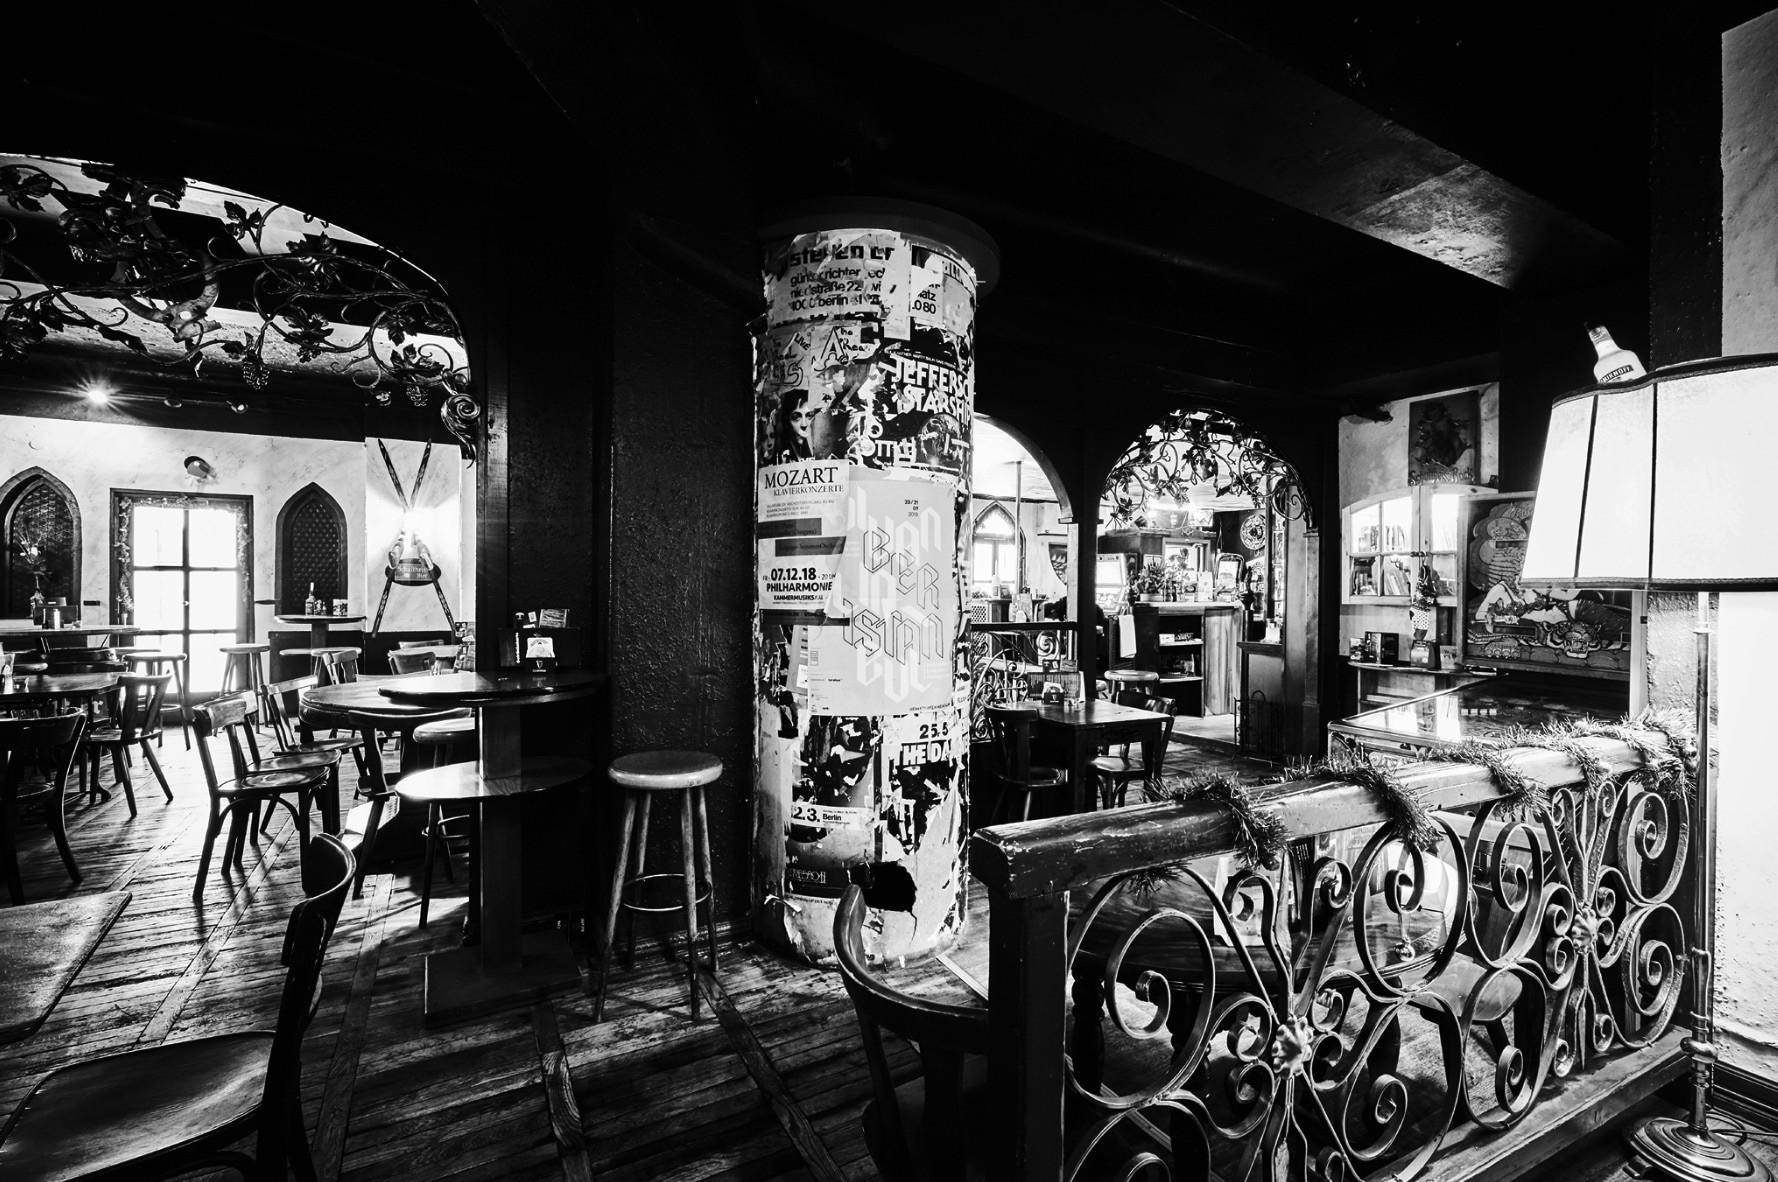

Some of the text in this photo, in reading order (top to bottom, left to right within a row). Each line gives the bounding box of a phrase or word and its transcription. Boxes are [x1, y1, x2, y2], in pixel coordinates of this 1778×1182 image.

[818, 294, 849, 308] berlin
[794, 332, 811, 351] LIVE
[764, 466, 839, 490] MOZART
[773, 484, 845, 497] KLAVIERKONZERTE
[770, 566, 817, 582] 07.12.18
[766, 581, 833, 593] PHILHARMONIE
[822, 812, 842, 822] Berlin
